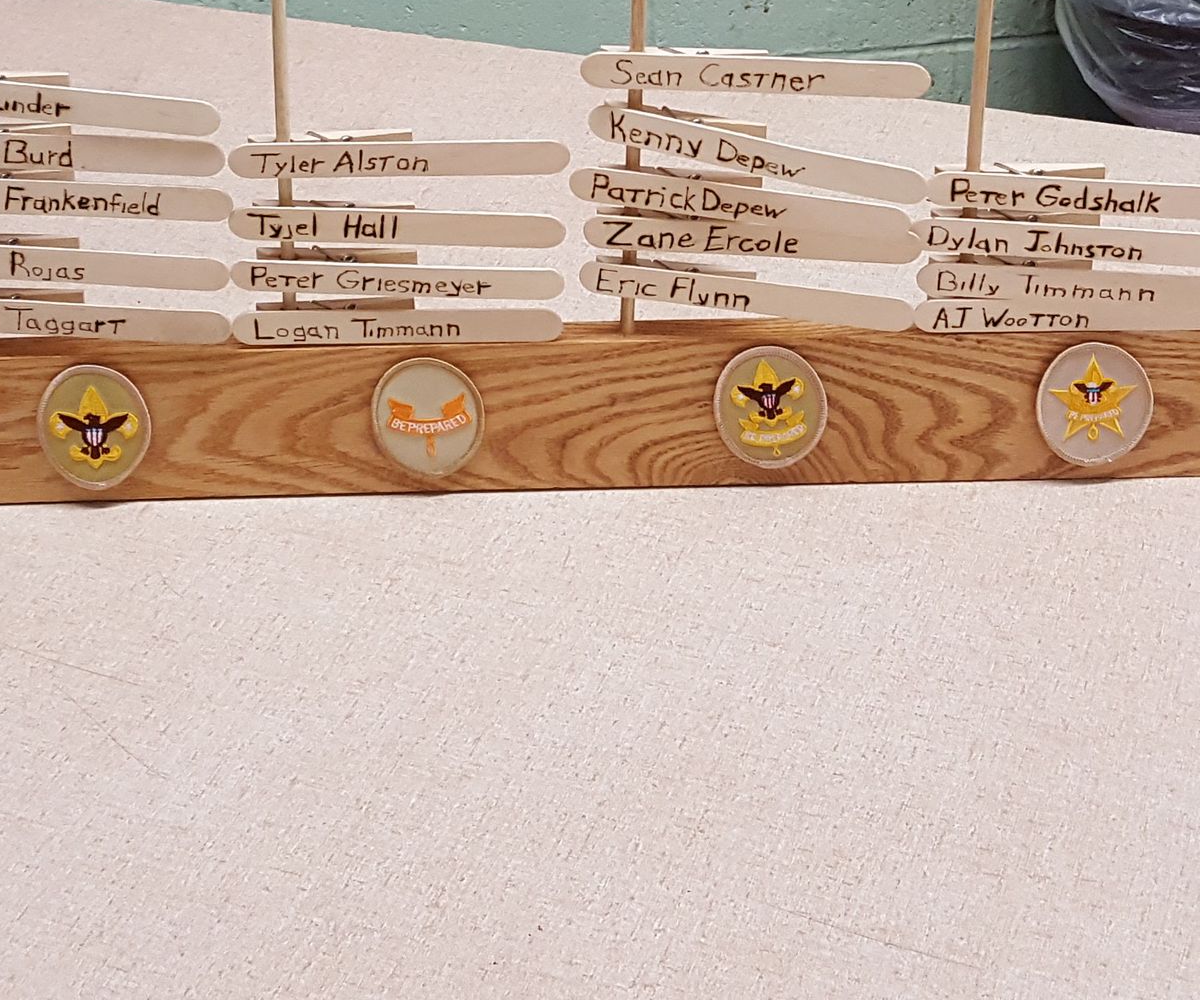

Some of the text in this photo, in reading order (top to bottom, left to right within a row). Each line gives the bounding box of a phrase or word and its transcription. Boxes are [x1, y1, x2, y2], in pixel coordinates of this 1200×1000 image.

[610, 59, 683, 87] Sean
[4, 139, 73, 168] Burd
[609, 110, 807, 179] Kenny Depew
[250, 152, 326, 177] Tyler
[4, 186, 161, 216] Frankenfield
[702, 187, 788, 221] Depew
[1036, 184, 1162, 214] Godshalk
[344, 214, 399, 239] Hall
[603, 220, 800, 254] Zane Ercole
[927, 225, 1008, 253] Dylan
[10, 251, 85, 281] Rojas
[337, 270, 492, 297] Griesmeyer
[596, 268, 750, 310] Eric Flynn
[937, 270, 1155, 302] Billy Timmann
[254, 317, 461, 342] Logan Timmann
[933, 307, 972, 330] AJ
[407, 414, 467, 434] PREPARED
